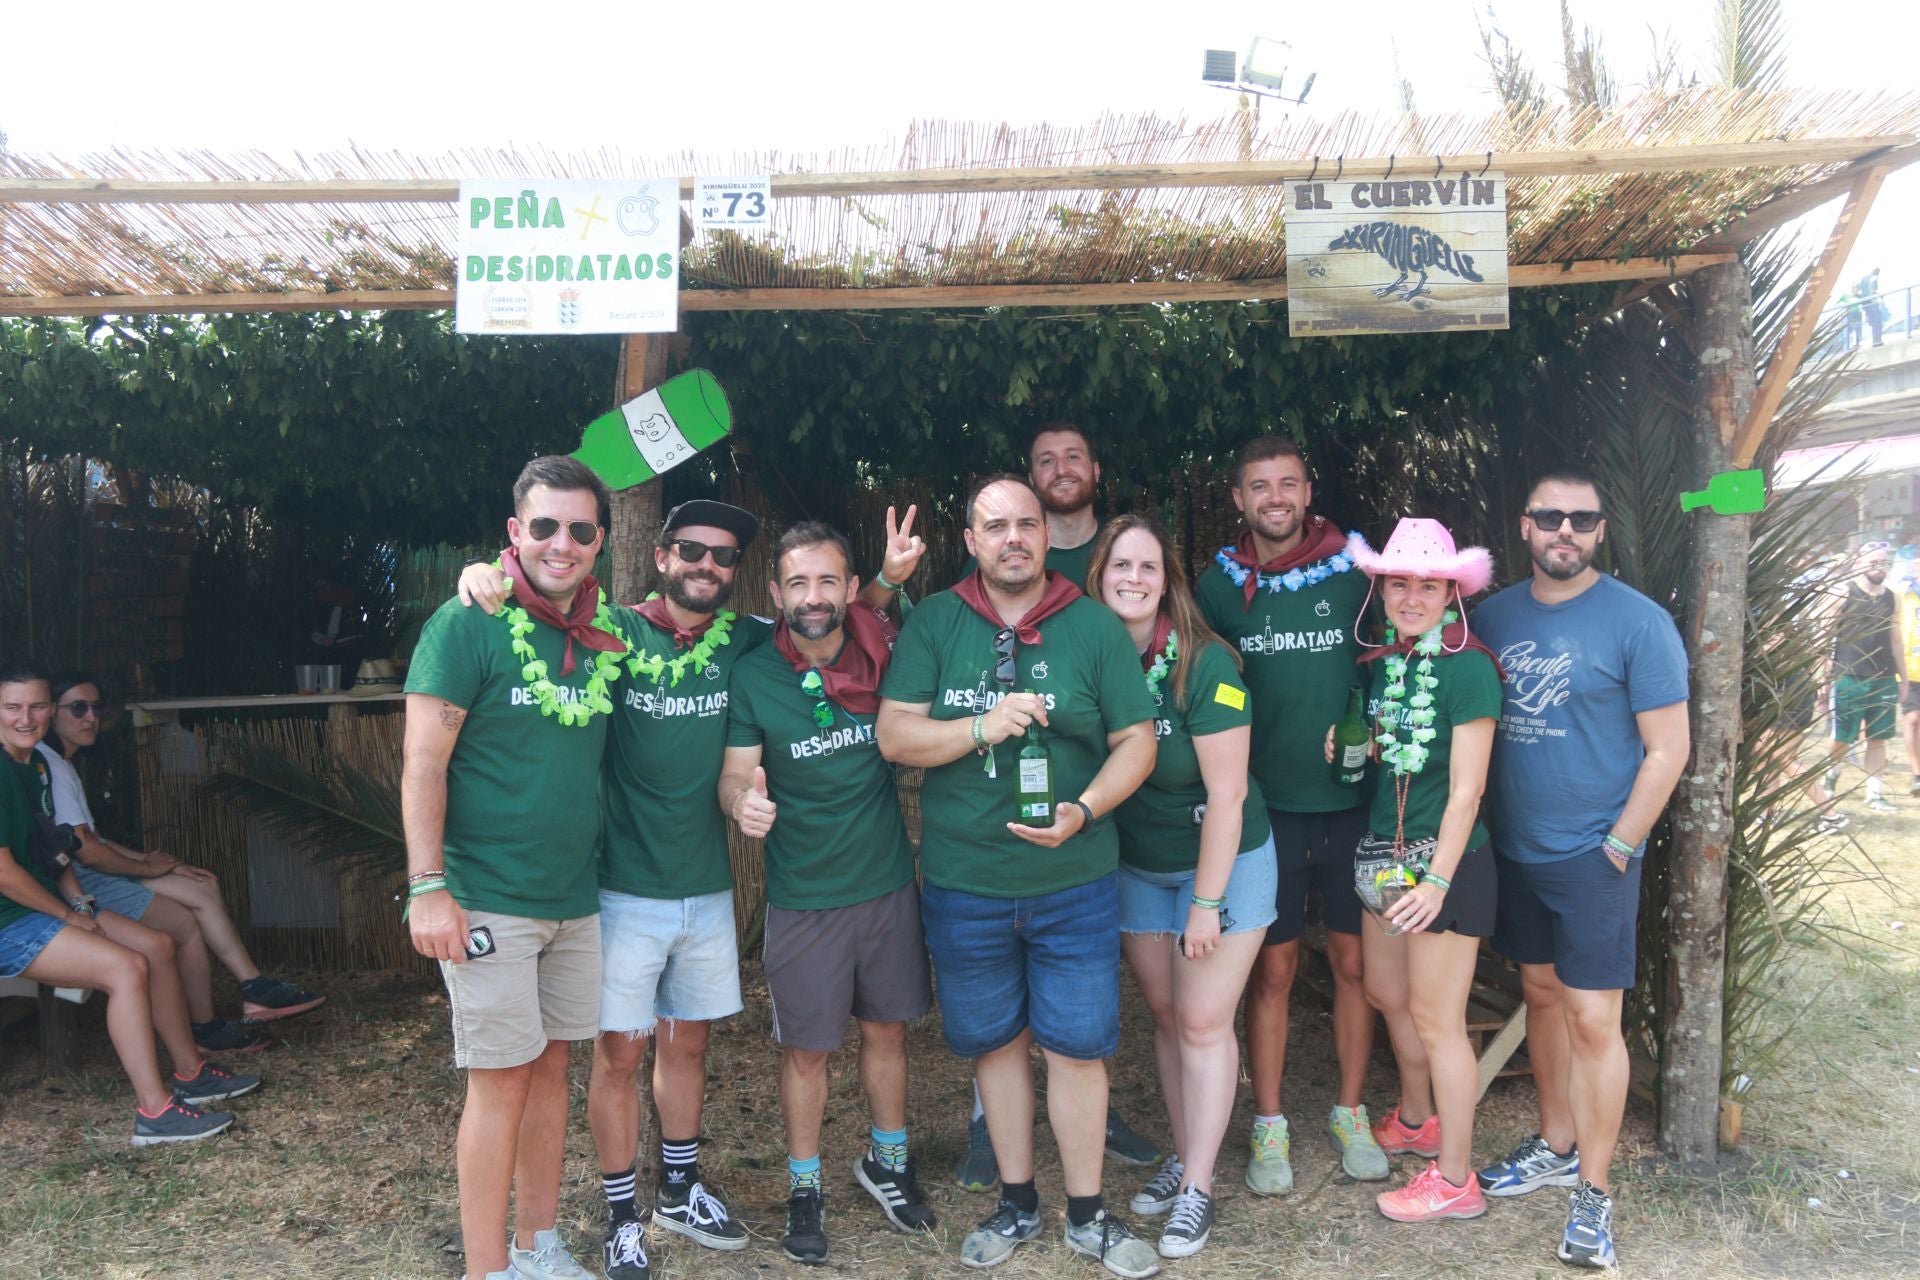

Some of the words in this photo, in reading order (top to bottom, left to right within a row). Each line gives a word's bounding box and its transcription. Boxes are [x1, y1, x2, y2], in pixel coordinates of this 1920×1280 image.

[722, 191, 766, 218] 73
[1294, 183, 1332, 210] EL
[1351, 171, 1495, 208] CUERVÍN
[469, 189, 565, 229] PEÑA
[1508, 673, 1570, 716] Life
[1510, 716, 1526, 724] MORE
[1526, 717, 1547, 727] THINGS
[1515, 725, 1534, 735] CHECK
[1534, 727, 1545, 736] THE
[1545, 728, 1568, 737] PHONE
